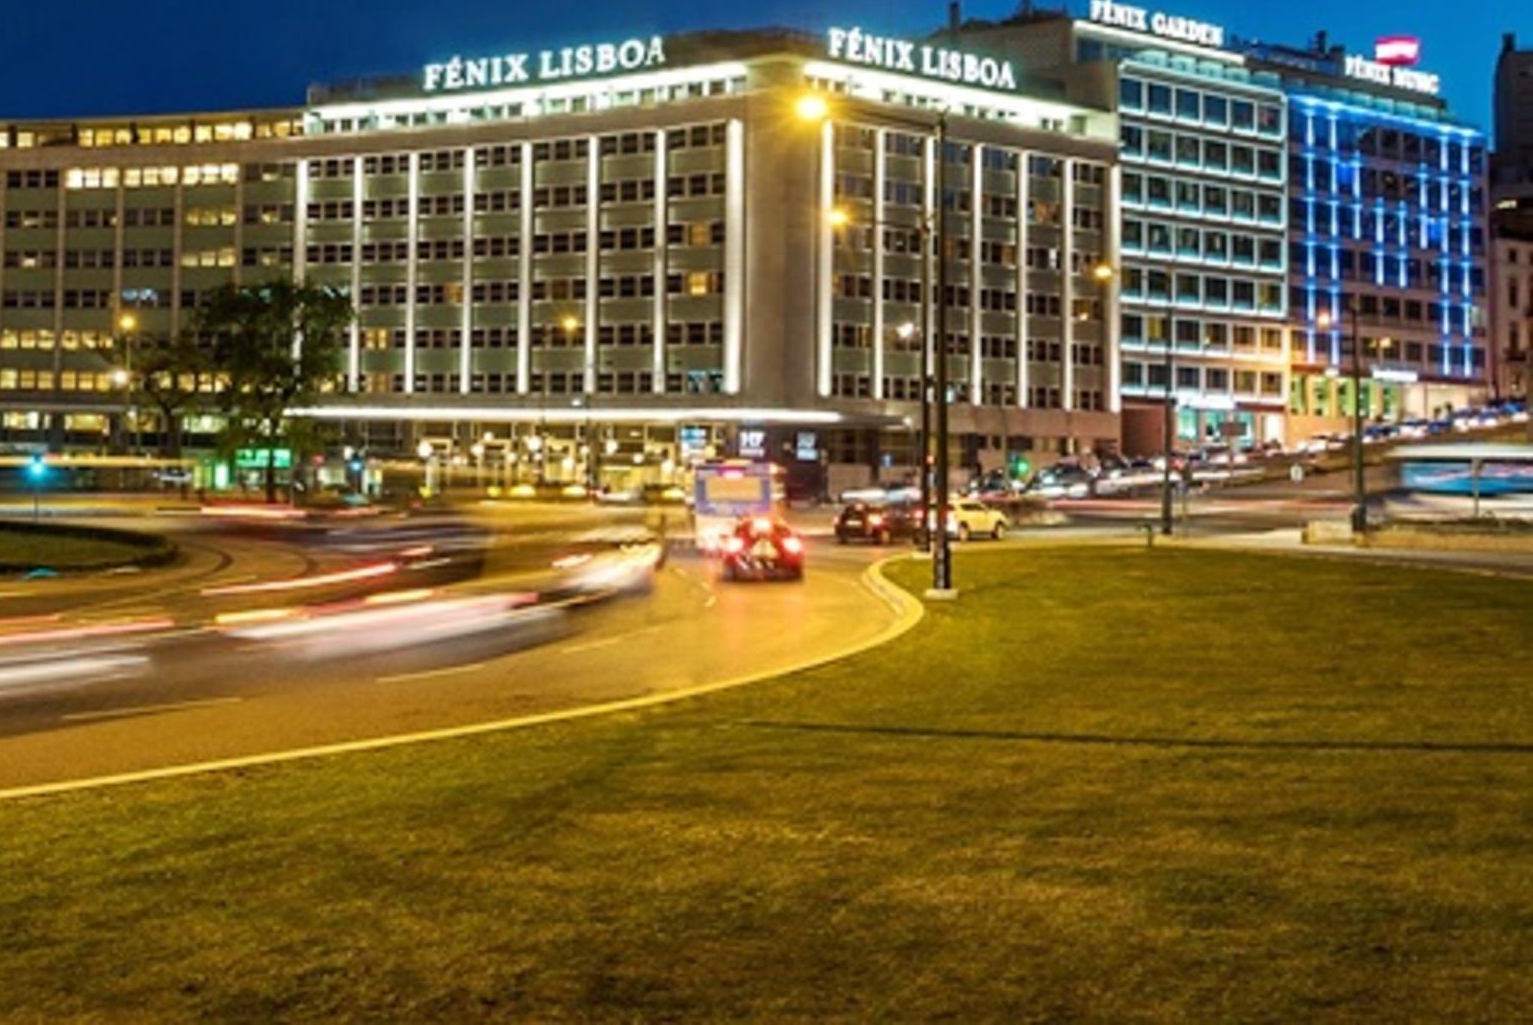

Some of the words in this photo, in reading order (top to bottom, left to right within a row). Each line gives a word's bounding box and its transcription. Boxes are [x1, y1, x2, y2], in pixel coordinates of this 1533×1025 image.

[423, 54, 530, 91] FÉNIX
[539, 35, 667, 79] LISBOA
[828, 26, 915, 71] FÉNIX
[922, 45, 1017, 90] LISBOA
